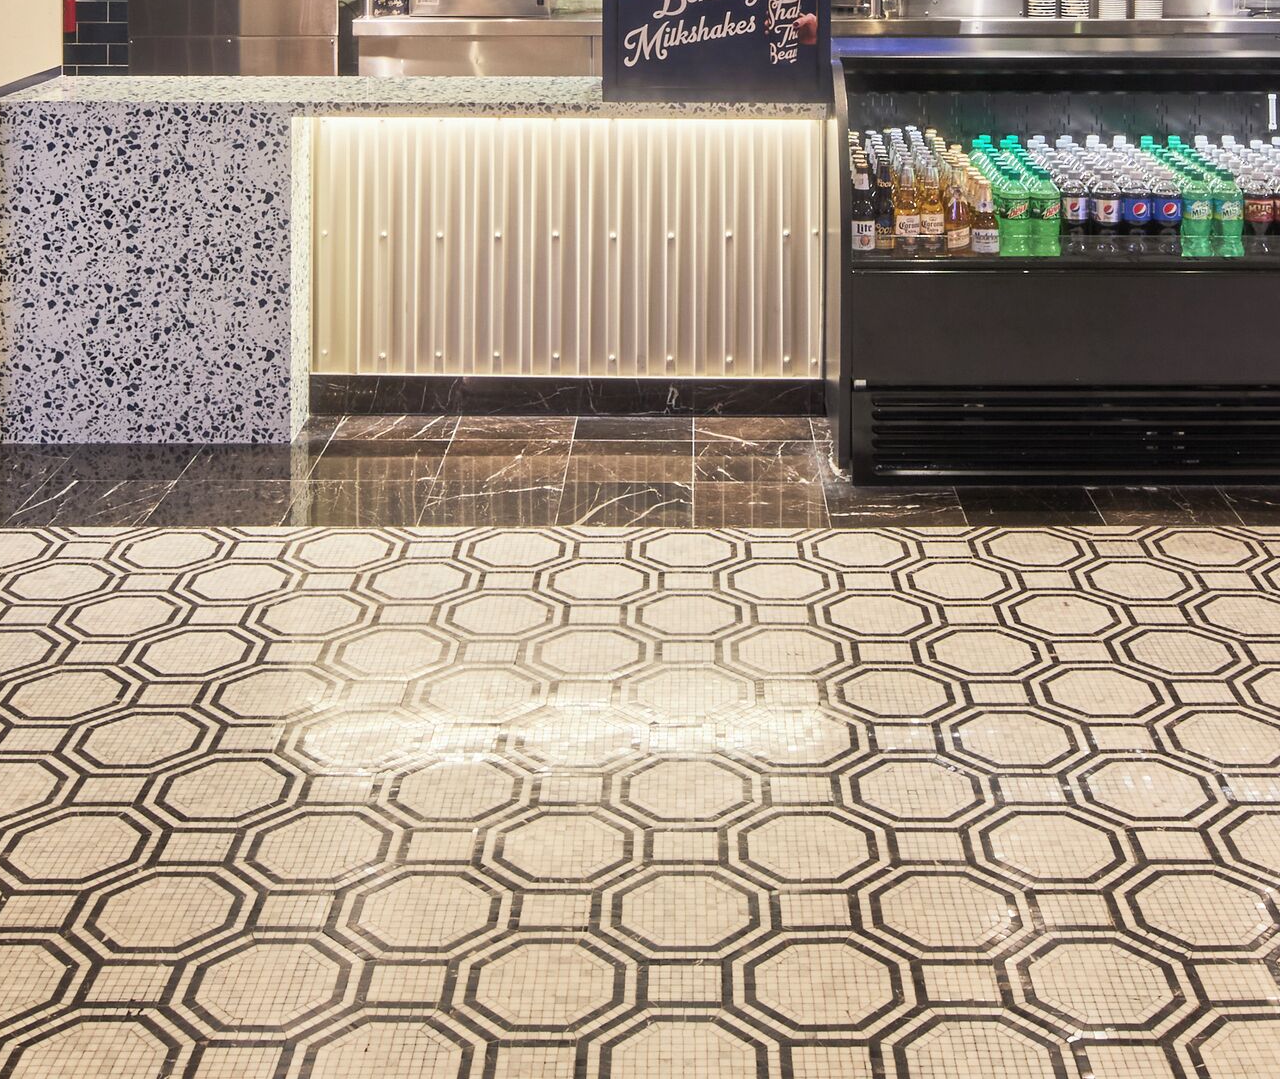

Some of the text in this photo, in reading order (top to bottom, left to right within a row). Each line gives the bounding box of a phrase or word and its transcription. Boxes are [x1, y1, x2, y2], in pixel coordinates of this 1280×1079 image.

[624, 11, 756, 67] Milkshakes
[1248, 204, 1272, 213] MUG
[857, 224, 873, 234] Lite
